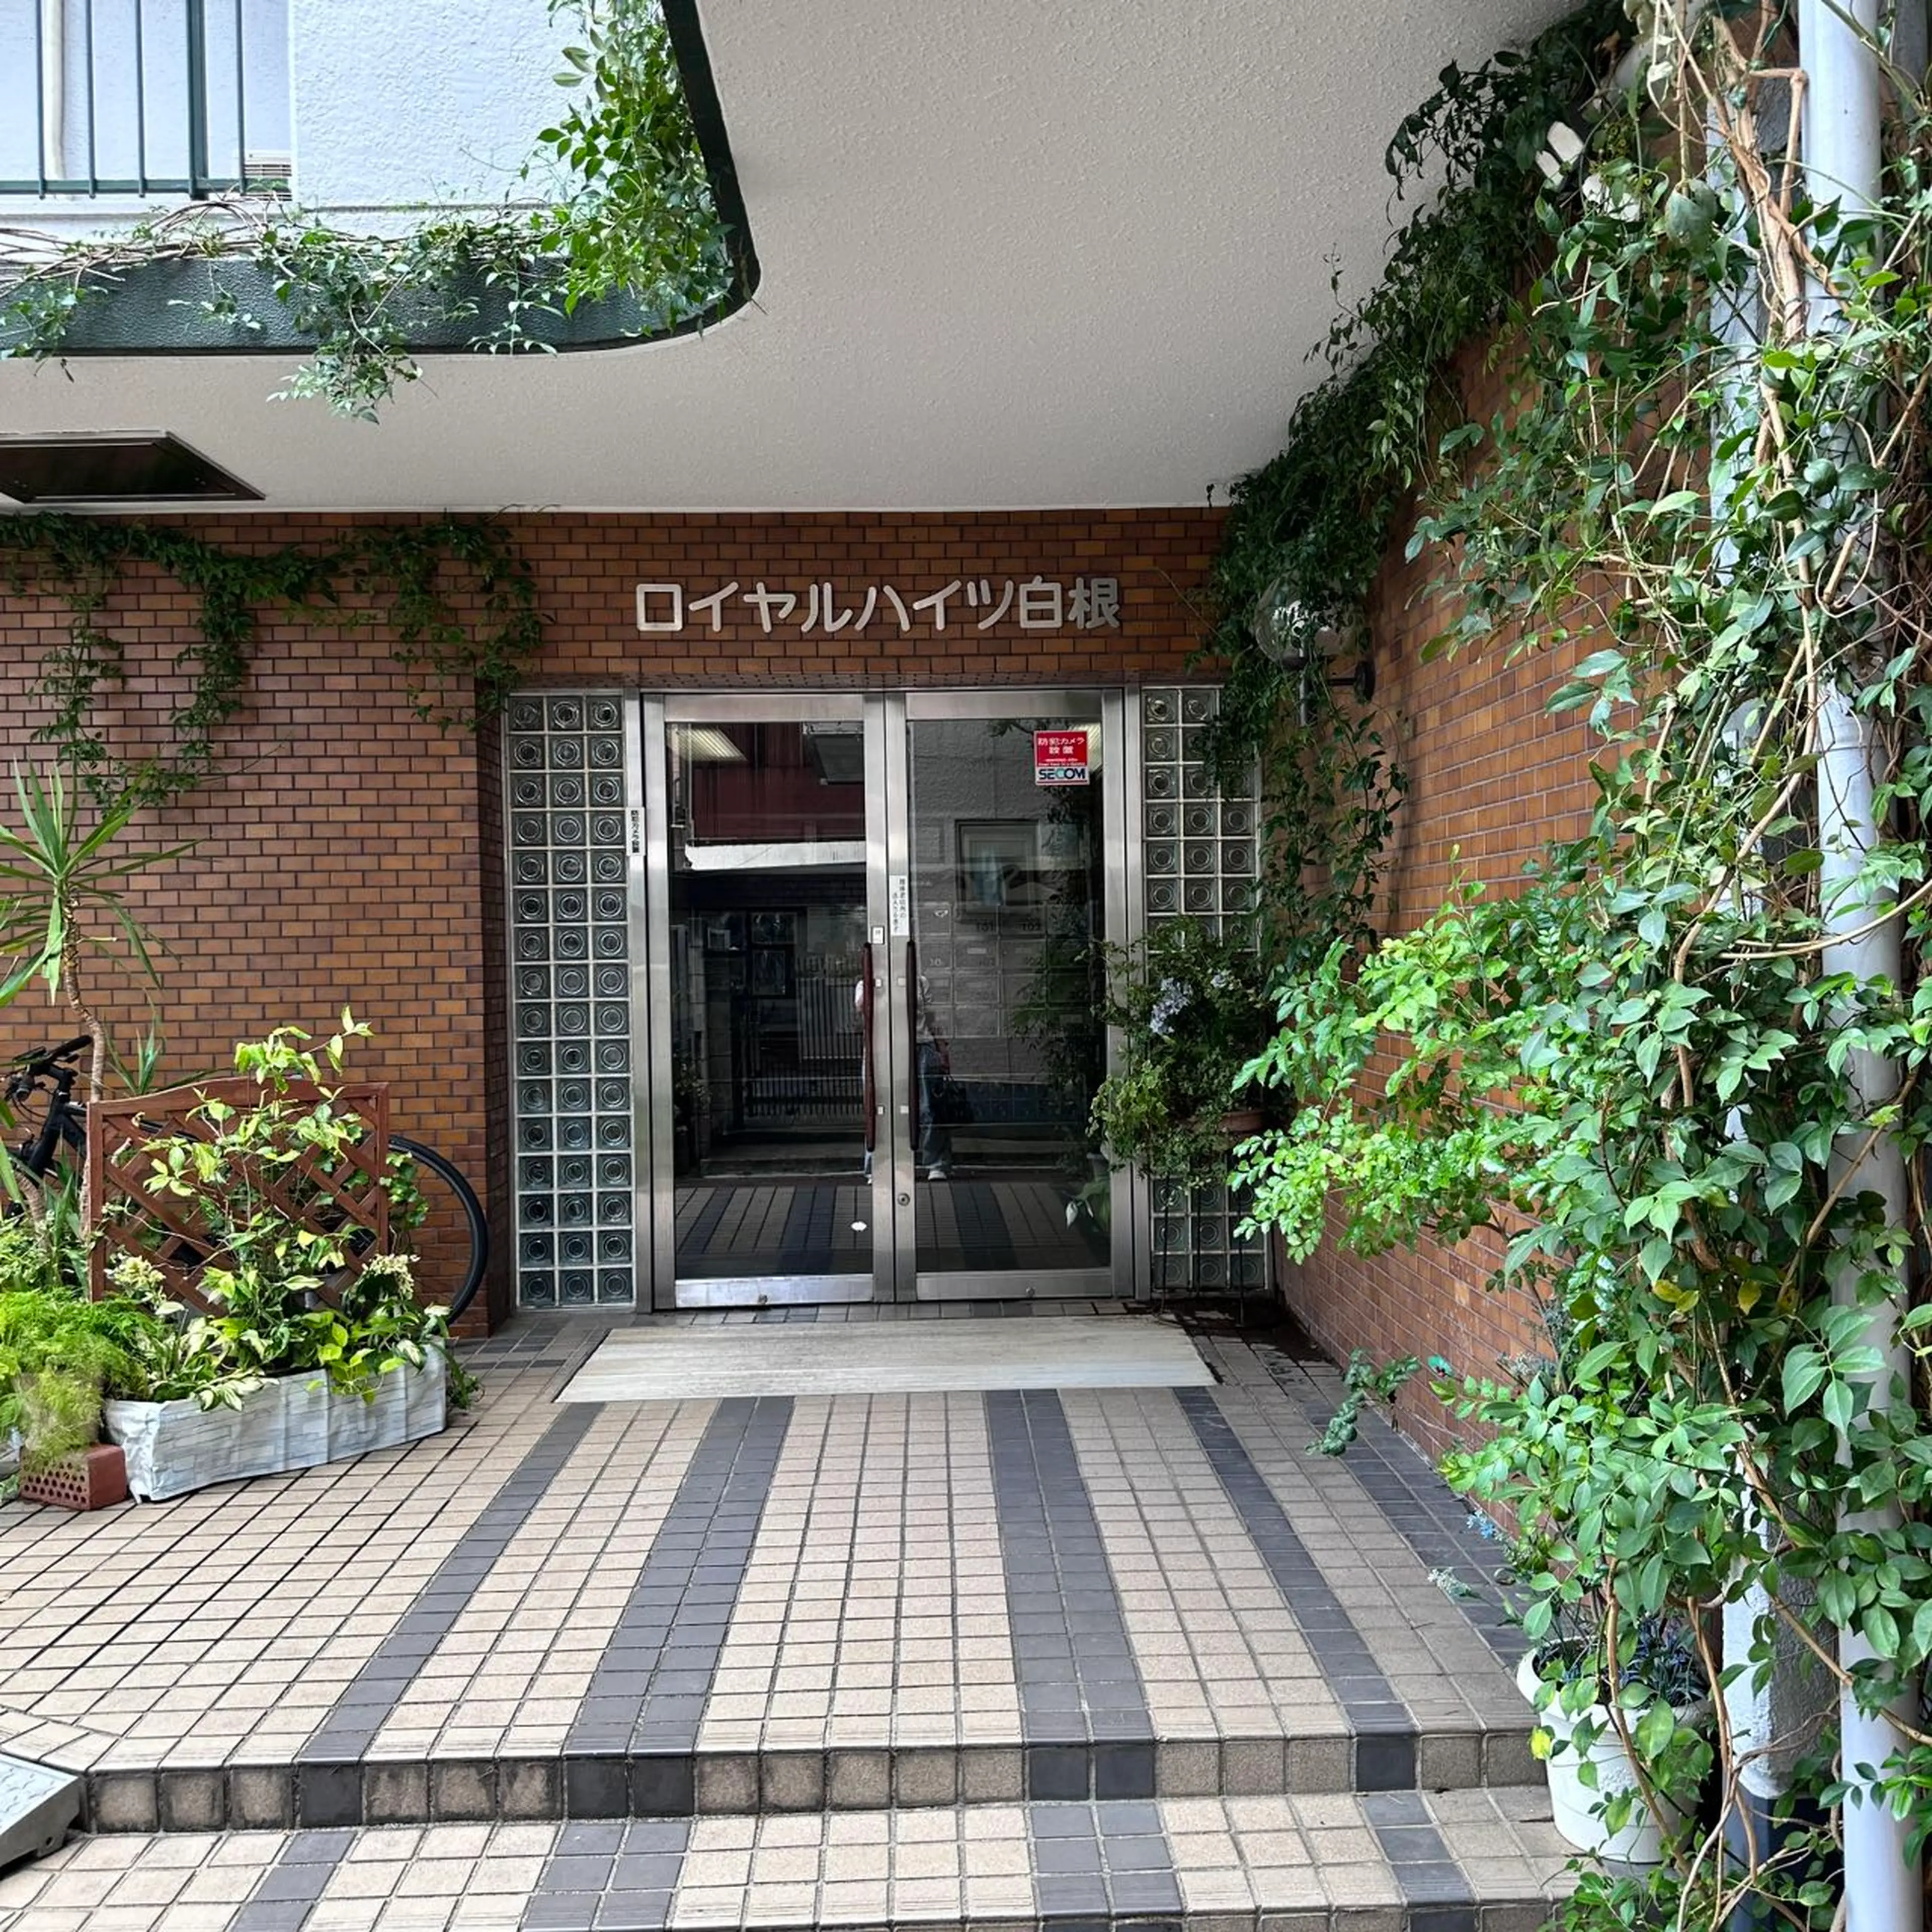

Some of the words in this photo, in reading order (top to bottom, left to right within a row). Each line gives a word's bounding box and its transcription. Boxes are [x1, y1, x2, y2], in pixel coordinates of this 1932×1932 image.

[635, 577, 1120, 632] ロイヤルハイツ白根
[1038, 737, 1085, 746] 防犯カメラ
[1038, 768, 1085, 779] SECOM
